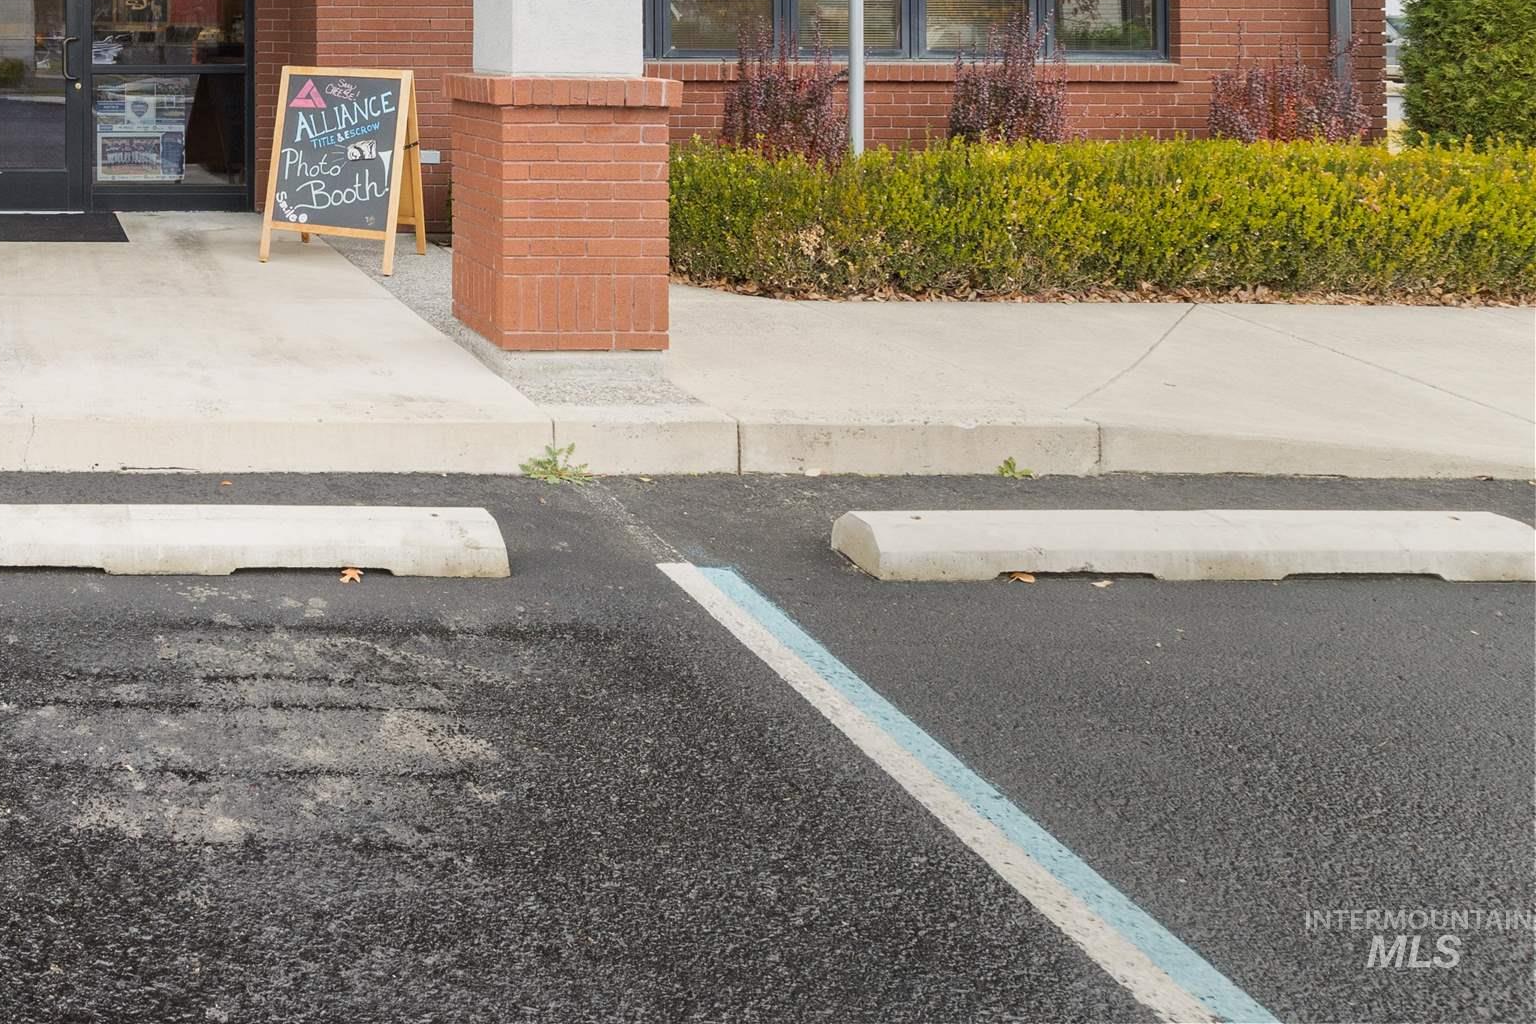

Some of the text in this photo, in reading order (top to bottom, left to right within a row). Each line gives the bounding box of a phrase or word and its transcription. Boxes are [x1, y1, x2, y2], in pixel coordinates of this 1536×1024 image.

[337, 79, 357, 91] Say
[294, 91, 396, 143] ALLIANCE
[311, 134, 337, 151] TITLE
[281, 148, 342, 180] Photo
